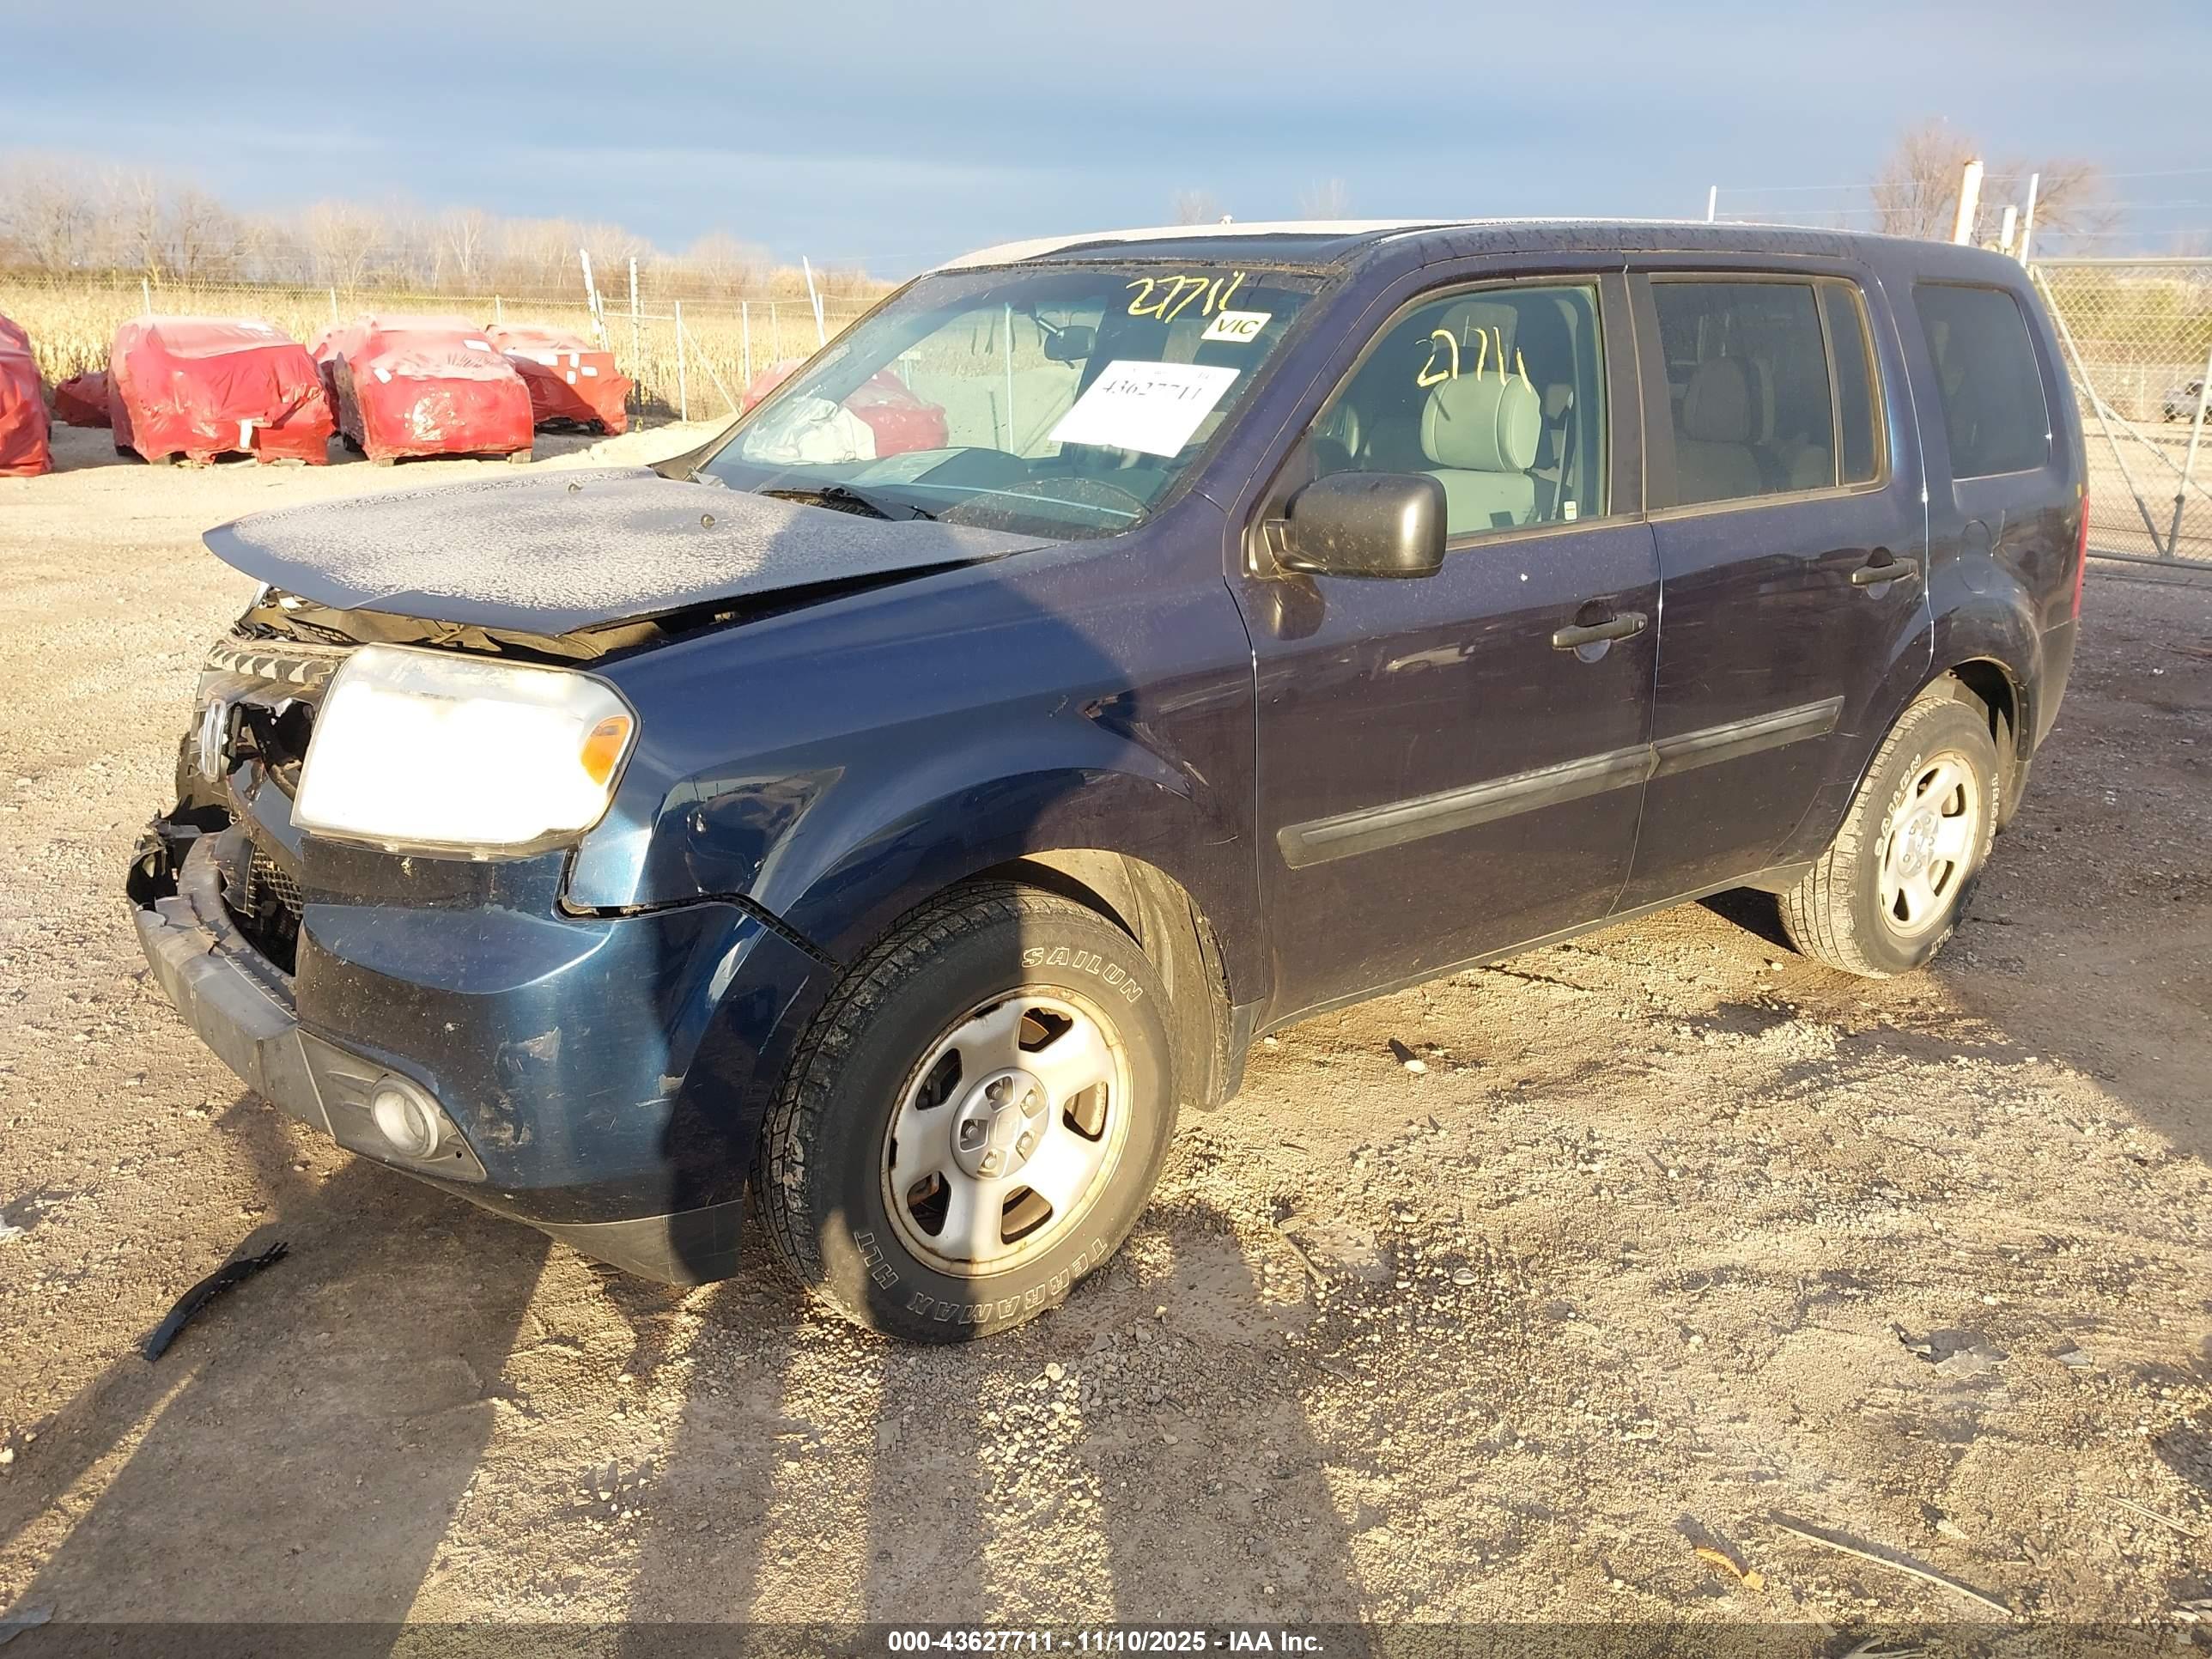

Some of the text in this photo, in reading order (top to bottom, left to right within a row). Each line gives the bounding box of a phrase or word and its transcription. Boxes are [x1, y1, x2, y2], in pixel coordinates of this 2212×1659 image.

[1218, 319, 1259, 334] VIC
[1021, 946, 1144, 1003] SAILUN
[853, 1230, 1109, 1326] TERRAMAX HLT
